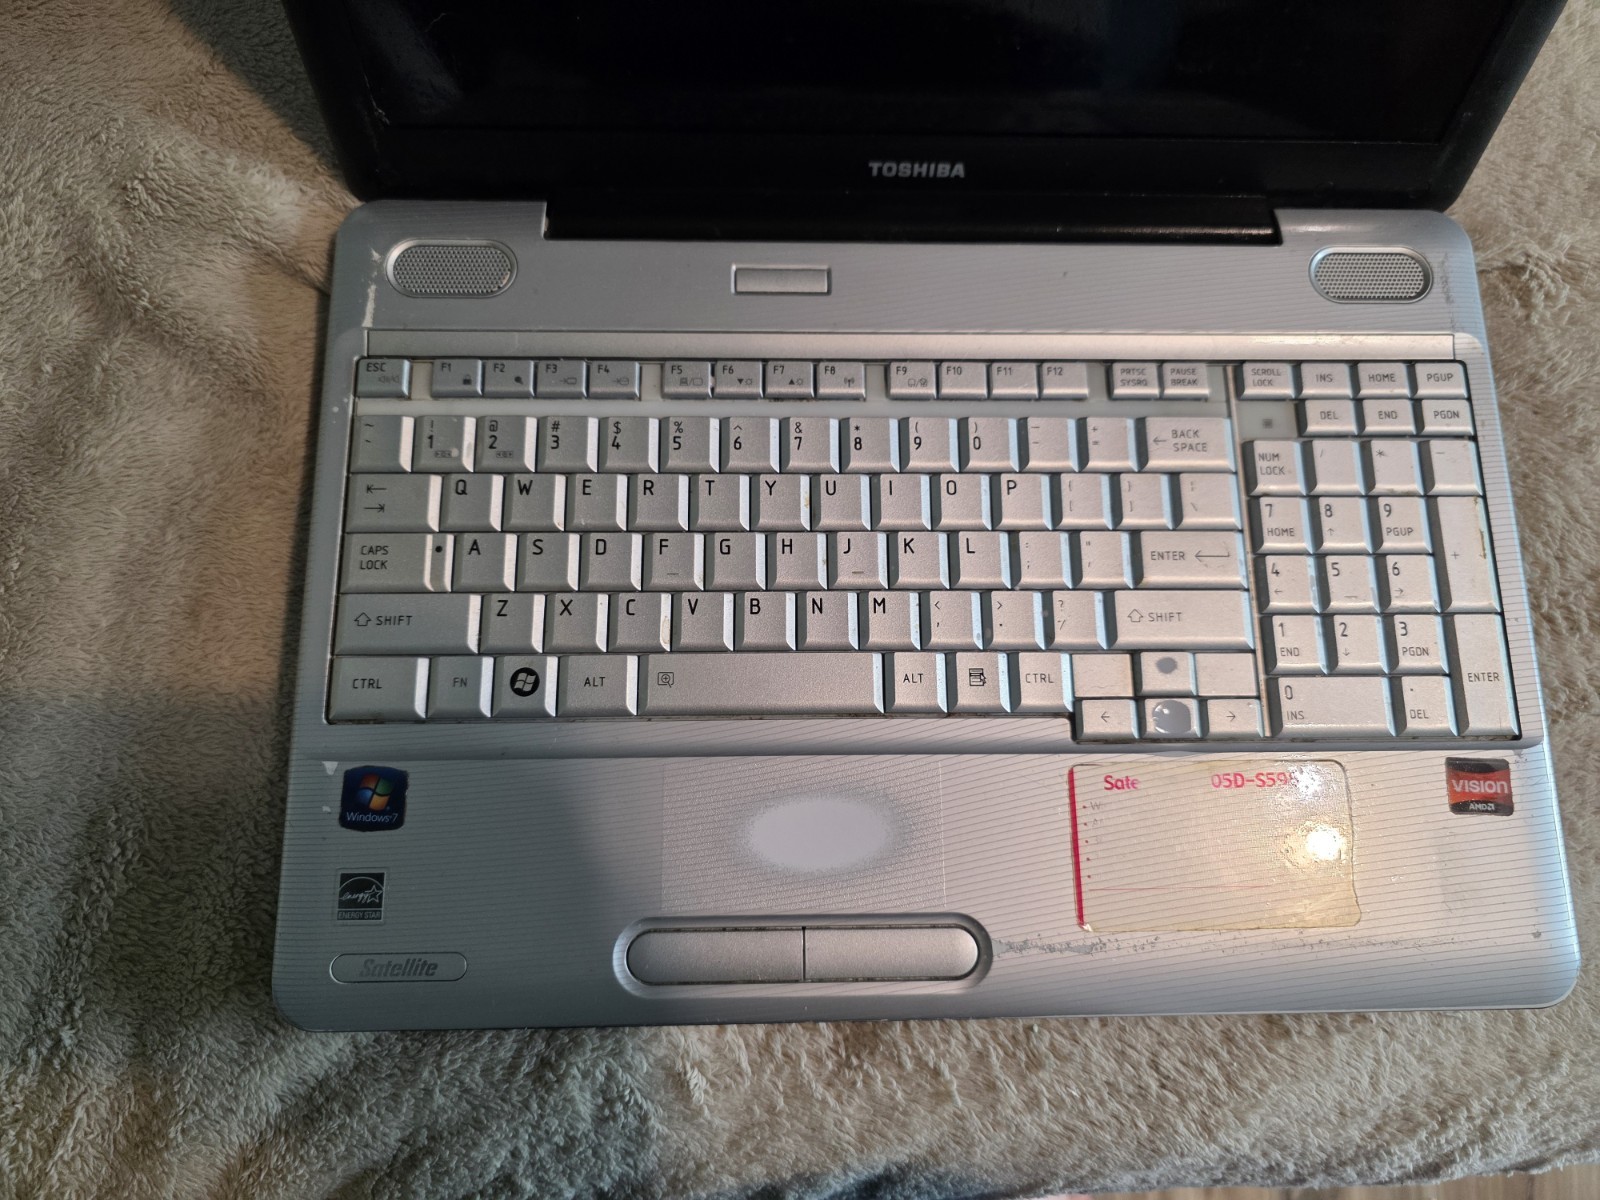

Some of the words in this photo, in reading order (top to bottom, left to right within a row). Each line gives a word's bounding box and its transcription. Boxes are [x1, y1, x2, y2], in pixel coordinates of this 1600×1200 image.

[868, 162, 965, 178] TOSHIBA
[366, 363, 386, 372] ESC
[441, 363, 451, 372] F1
[493, 363, 506, 373] F2
[545, 364, 558, 373] F3
[597, 364, 610, 374] F4
[671, 365, 683, 375] F5
[722, 365, 734, 375] F6
[773, 365, 785, 375] F7
[824, 365, 836, 375] F8
[896, 366, 907, 375] F9
[946, 366, 963, 376] F10
[996, 366, 1013, 376] F11
[1047, 366, 1063, 376] F12
[1120, 368, 1147, 376] PRTSC
[1170, 368, 1197, 376] PAUSE
[1251, 368, 1281, 376] SCROLL
[1119, 378, 1148, 387] SYSRQ
[1170, 378, 1198, 387] BREAK
[1252, 378, 1274, 387] LOCK
[1315, 373, 1333, 383] INS
[1368, 373, 1397, 383] HOME
[1426, 373, 1454, 383] PGUP
[1319, 410, 1339, 420] DEL
[1378, 410, 1398, 420] END
[1433, 410, 1460, 420] PGDN
[489, 420, 498, 432] @
[551, 421, 560, 431] #
[613, 421, 622, 434] $
[674, 421, 683, 434] %
[794, 422, 803, 434] &
[1171, 429, 1200, 439] BACK
[428, 435, 434, 449] 1
[489, 435, 498, 450] 2
[551, 435, 560, 449] 3
[611, 436, 621, 450] 4
[673, 436, 682, 450] 5
[733, 436, 742, 450] 6
[794, 436, 802, 451] 7
[853, 437, 863, 451] 8
[913, 437, 922, 451] 9
[973, 437, 982, 451] 0
[1172, 443, 1208, 453] SPACE
[1258, 452, 1280, 462] NUM
[1259, 466, 1286, 476] LOCK
[455, 479, 468, 496] Q
[517, 479, 534, 496] W
[582, 480, 592, 496] E
[643, 480, 654, 496] R
[704, 480, 716, 496] T
[765, 480, 777, 496] Y
[826, 480, 836, 496] U
[946, 480, 957, 496] O
[1006, 480, 1017, 496] P
[1265, 504, 1273, 518] 7
[1324, 504, 1333, 518] 8
[1383, 504, 1392, 518] 9
[1267, 527, 1295, 537] HOME
[1385, 527, 1414, 537] PGUP
[360, 546, 389, 555] CAPS
[468, 539, 481, 556] A
[532, 538, 544, 555] S
[595, 539, 607, 555] D
[659, 538, 669, 555] F
[719, 538, 731, 555] G
[781, 538, 793, 555] H
[843, 538, 851, 554] J
[903, 538, 915, 554] K
[966, 538, 976, 554] L
[1151, 551, 1186, 561] ENTER
[360, 560, 388, 570] LOCK
[1271, 562, 1280, 577] 4
[1331, 562, 1341, 577] 5
[1391, 562, 1401, 577] 6
[496, 600, 508, 617] Z
[559, 599, 573, 616] X
[626, 599, 636, 616] C
[688, 599, 699, 615] V
[750, 599, 761, 615] B
[811, 598, 823, 615] N
[873, 598, 886, 614] M
[376, 615, 413, 626] SHIFT
[1147, 612, 1182, 623] SHIFT
[1278, 622, 1285, 637] 1
[1339, 622, 1349, 637] 2
[1400, 622, 1409, 637] 3
[1280, 647, 1300, 657] END
[1401, 646, 1429, 657] PGDN
[452, 677, 468, 688] FN
[583, 676, 606, 688] ALT
[902, 673, 924, 684] ALT
[1025, 673, 1054, 684] CTRL
[1467, 672, 1500, 682] ENTER
[352, 678, 383, 690] CTRL
[1284, 685, 1293, 700] 0
[1286, 710, 1305, 720] INS
[1409, 709, 1429, 720] DEL
[1469, 803, 1487, 811] AMD
[338, 911, 364, 919] ENERGY
[364, 911, 381, 919] STAR
[360, 957, 439, 978] Satellite
